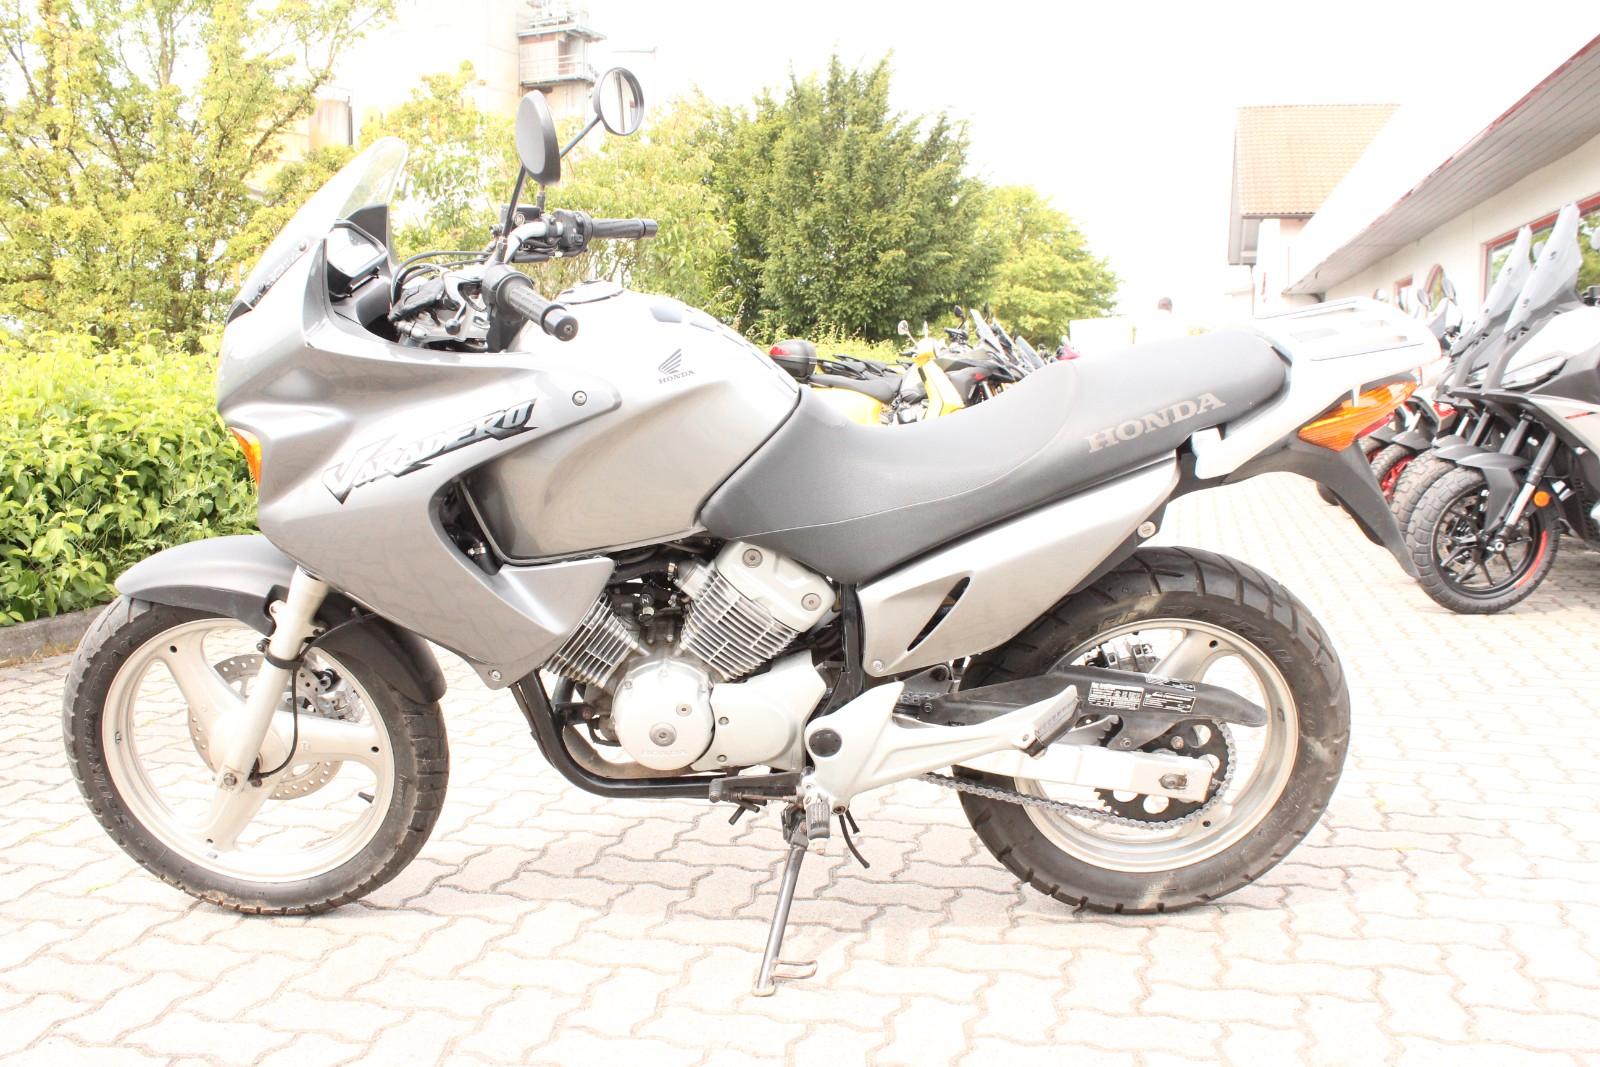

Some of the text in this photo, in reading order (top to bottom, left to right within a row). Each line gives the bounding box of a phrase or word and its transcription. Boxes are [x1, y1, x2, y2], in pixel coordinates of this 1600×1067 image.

[658, 370, 696, 384] HONDA
[321, 398, 538, 504] VARADERO
[1085, 392, 1226, 453] HONDA
